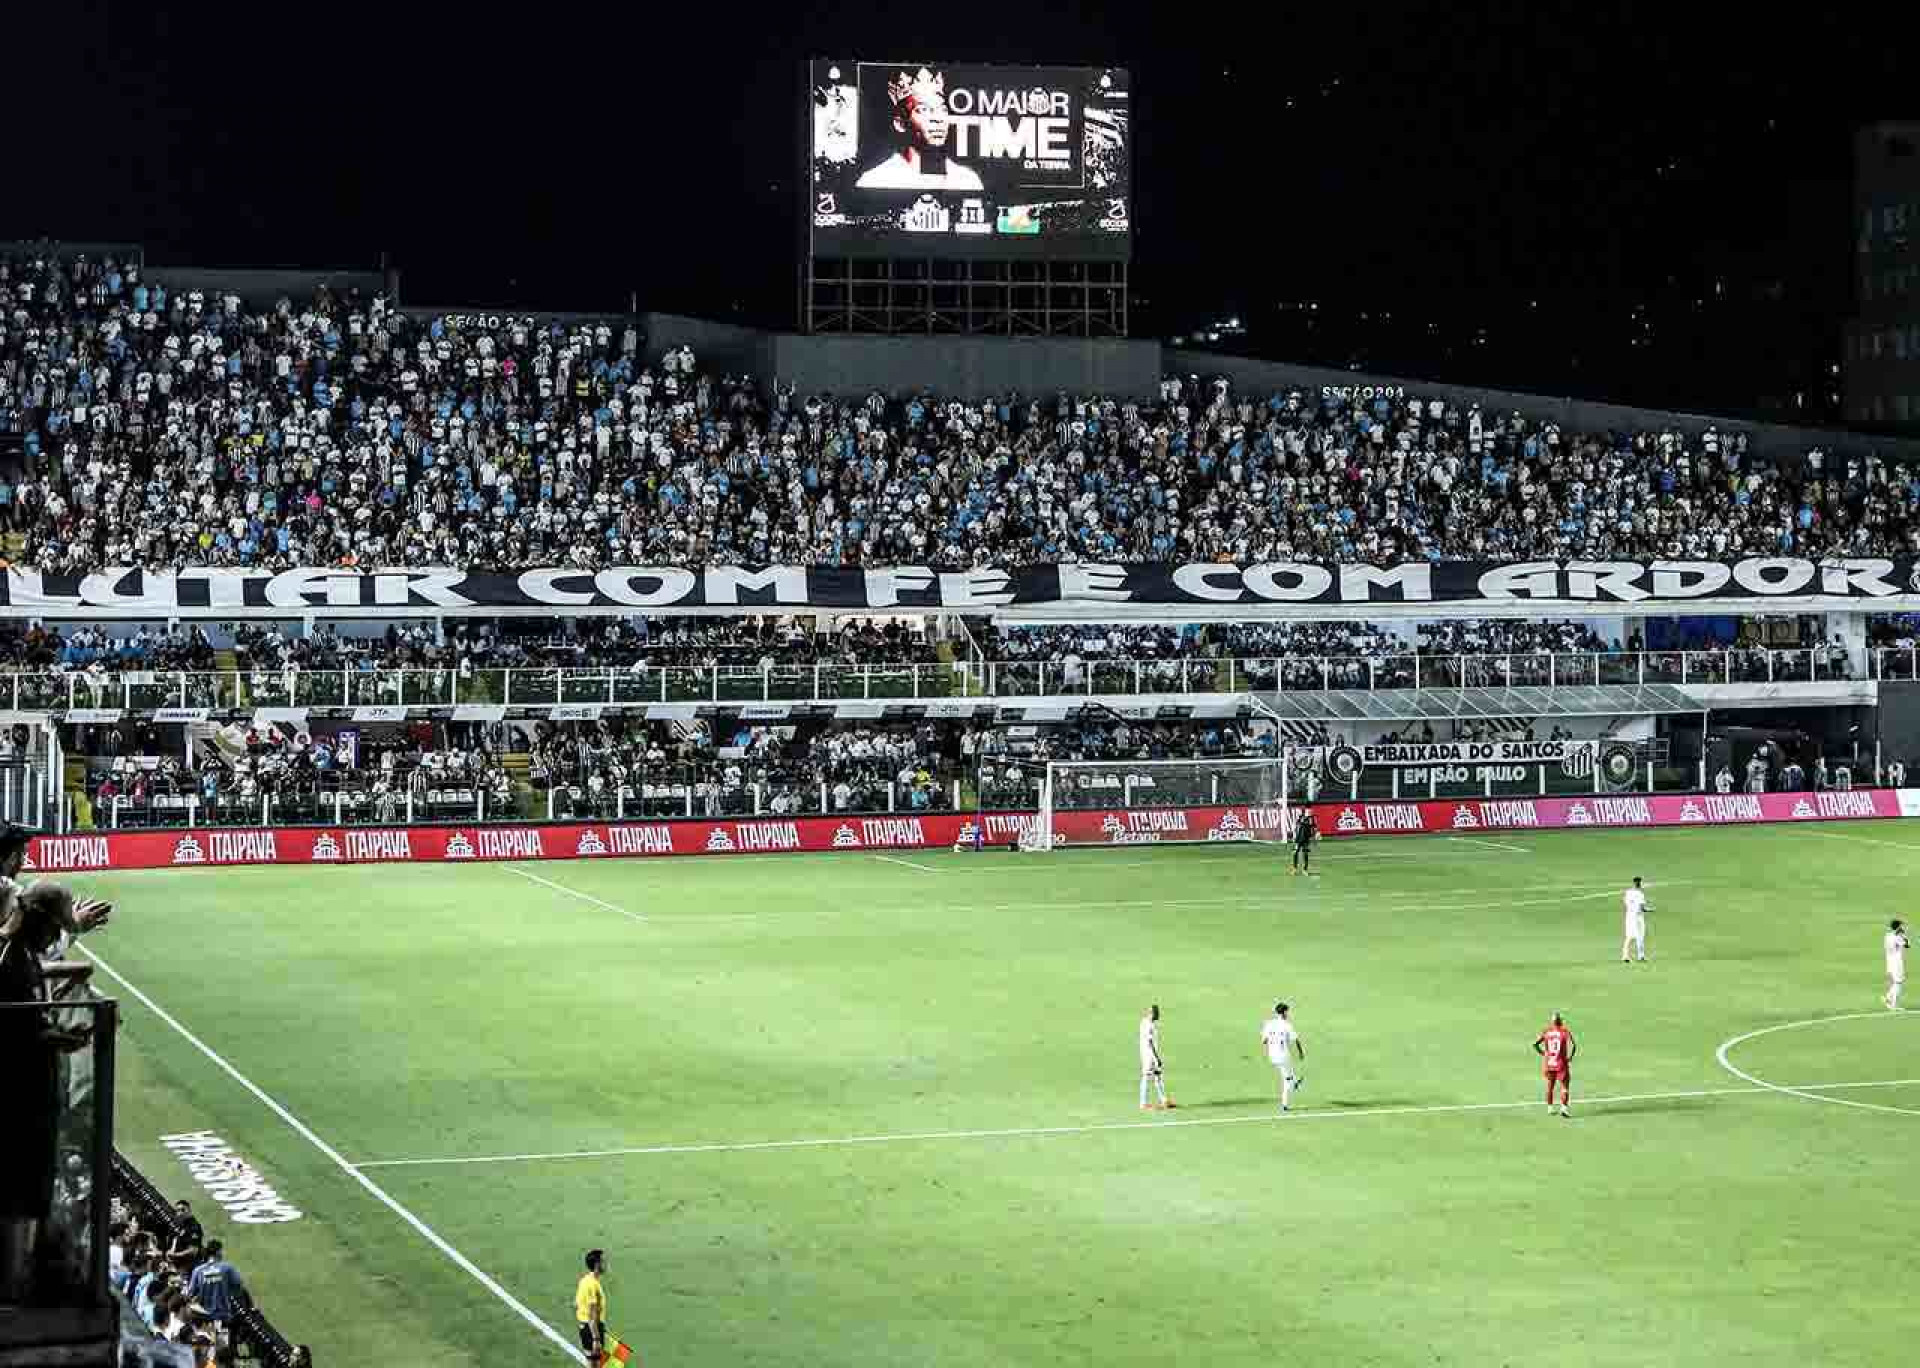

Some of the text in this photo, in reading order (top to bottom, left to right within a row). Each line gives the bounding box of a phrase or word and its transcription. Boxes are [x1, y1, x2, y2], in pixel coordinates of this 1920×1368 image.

[948, 88, 972, 113] O
[948, 115, 1070, 159] TIME
[9, 565, 477, 606] LUTAR
[517, 565, 809, 606] COM
[1059, 563, 1133, 600] E
[1172, 562, 1431, 601] COM
[1478, 557, 1902, 600] ARDOR
[1365, 742, 1564, 762] EMBAIXADA DO SANTOS
[1404, 764, 1527, 783] EM SÃO PAULO
[1365, 804, 1424, 829] ITAIPAVA
[1479, 801, 1538, 826] ITAIPAVA
[1593, 798, 1650, 824] ITAIPAVA
[1704, 794, 1764, 819] ITAIPAVA
[1816, 792, 1876, 816] ITAIPAVA
[345, 830, 411, 858] ITAIPAVA
[478, 830, 543, 855] ITAIPAVA
[608, 826, 673, 853] ITAIPAVA
[736, 823, 800, 849] ITAIPAVA
[863, 819, 925, 845] ITAIPAVA
[40, 837, 109, 868] ITAIPAVA
[209, 833, 277, 861] ITAIPAVA
